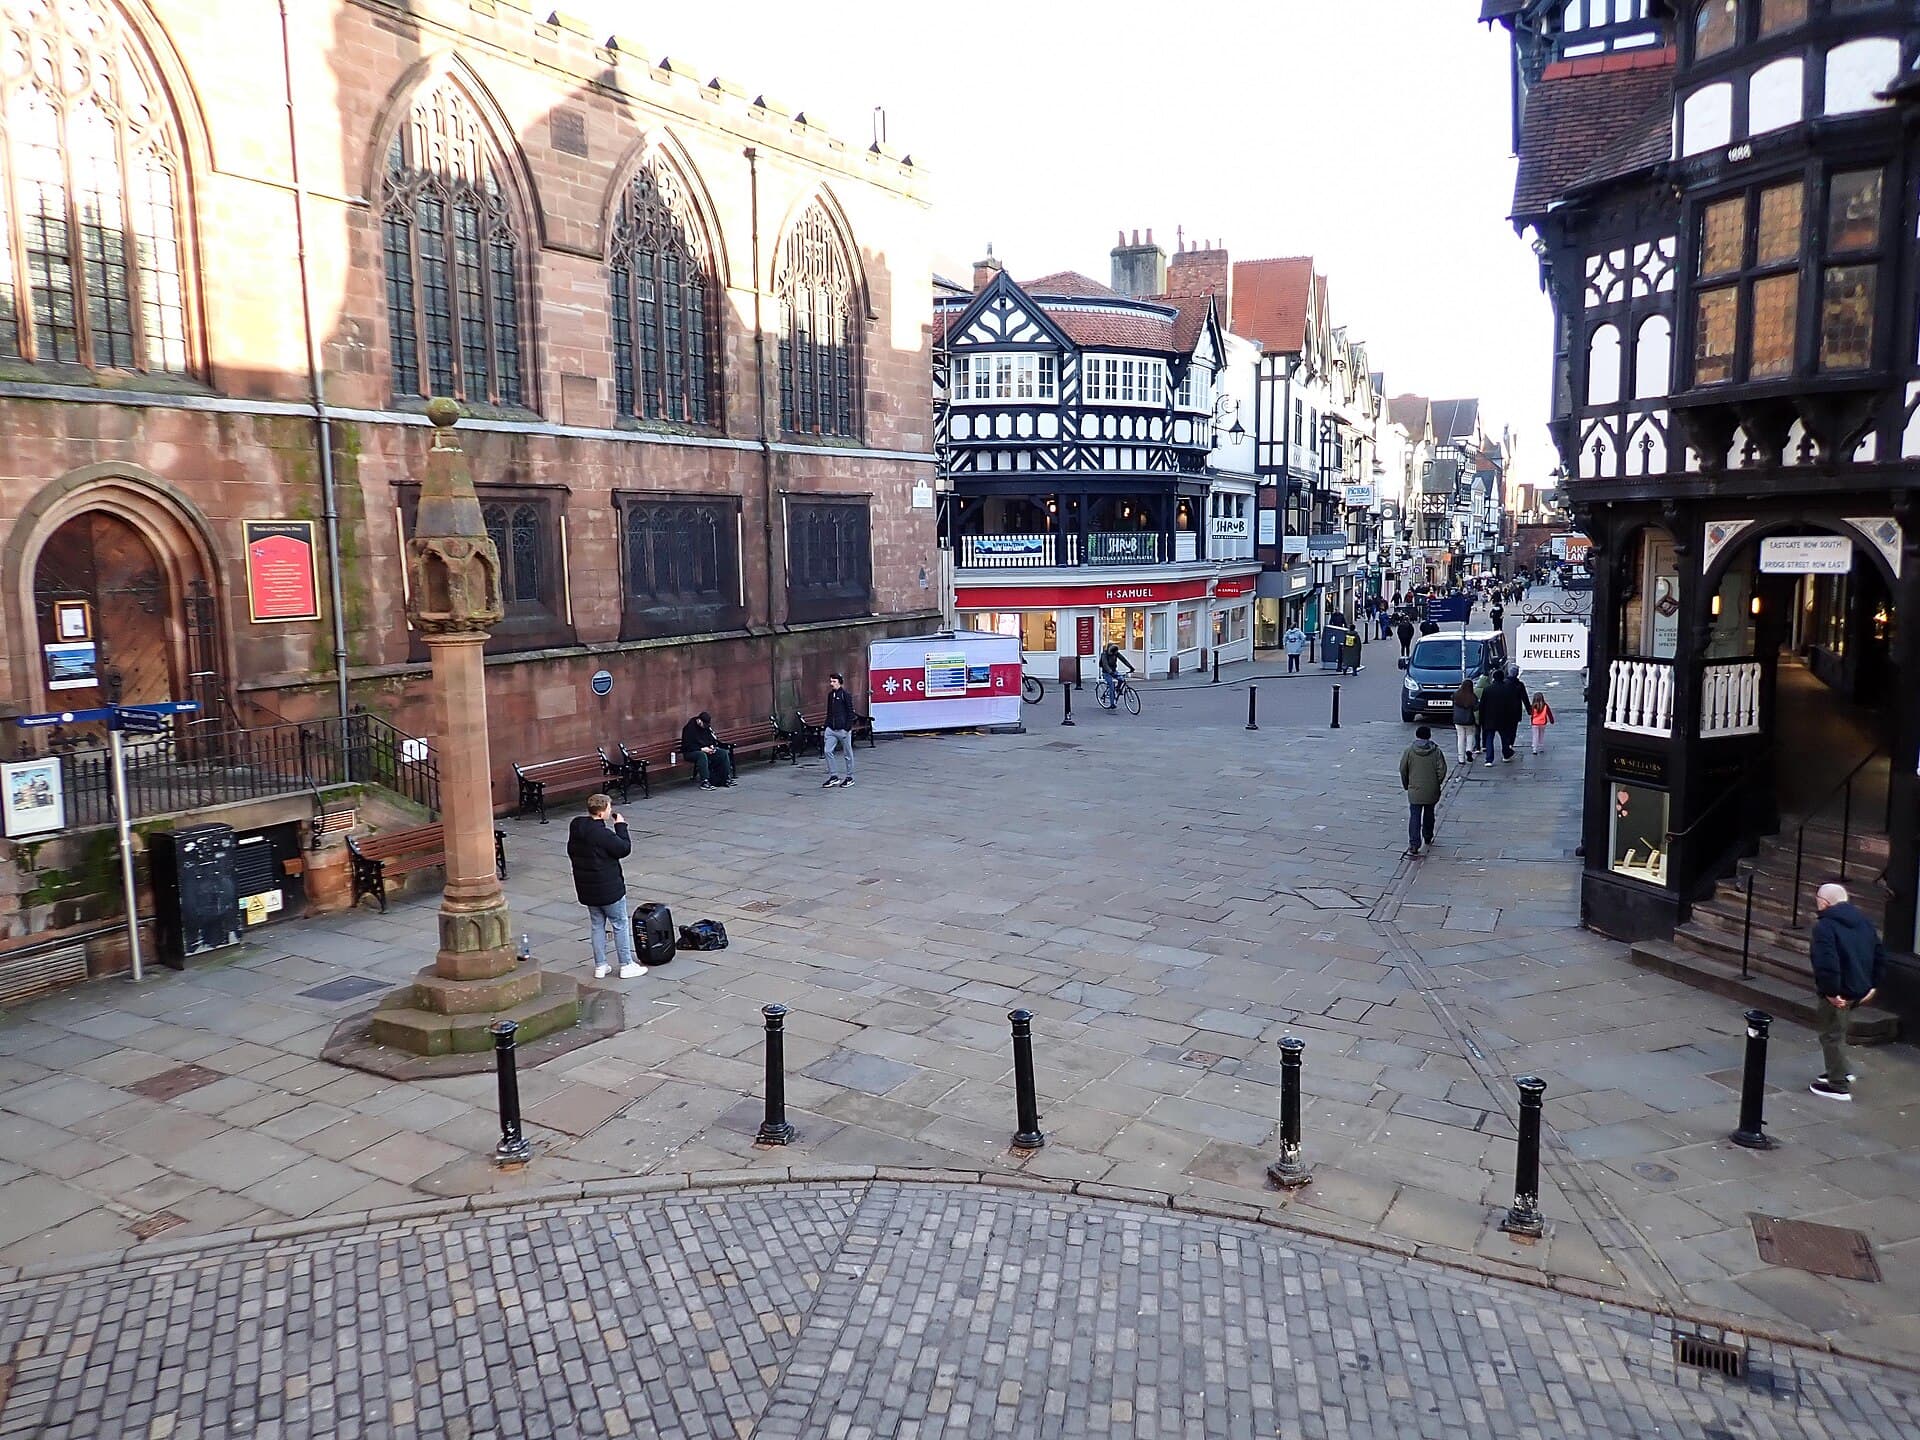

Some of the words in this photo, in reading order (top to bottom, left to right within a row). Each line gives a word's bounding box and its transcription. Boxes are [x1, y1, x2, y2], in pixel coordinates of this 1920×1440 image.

[1566, 553, 1584, 561] LAN
[1529, 633, 1574, 643] INFINITY
[1523, 649, 1581, 659] JEWELLERS
